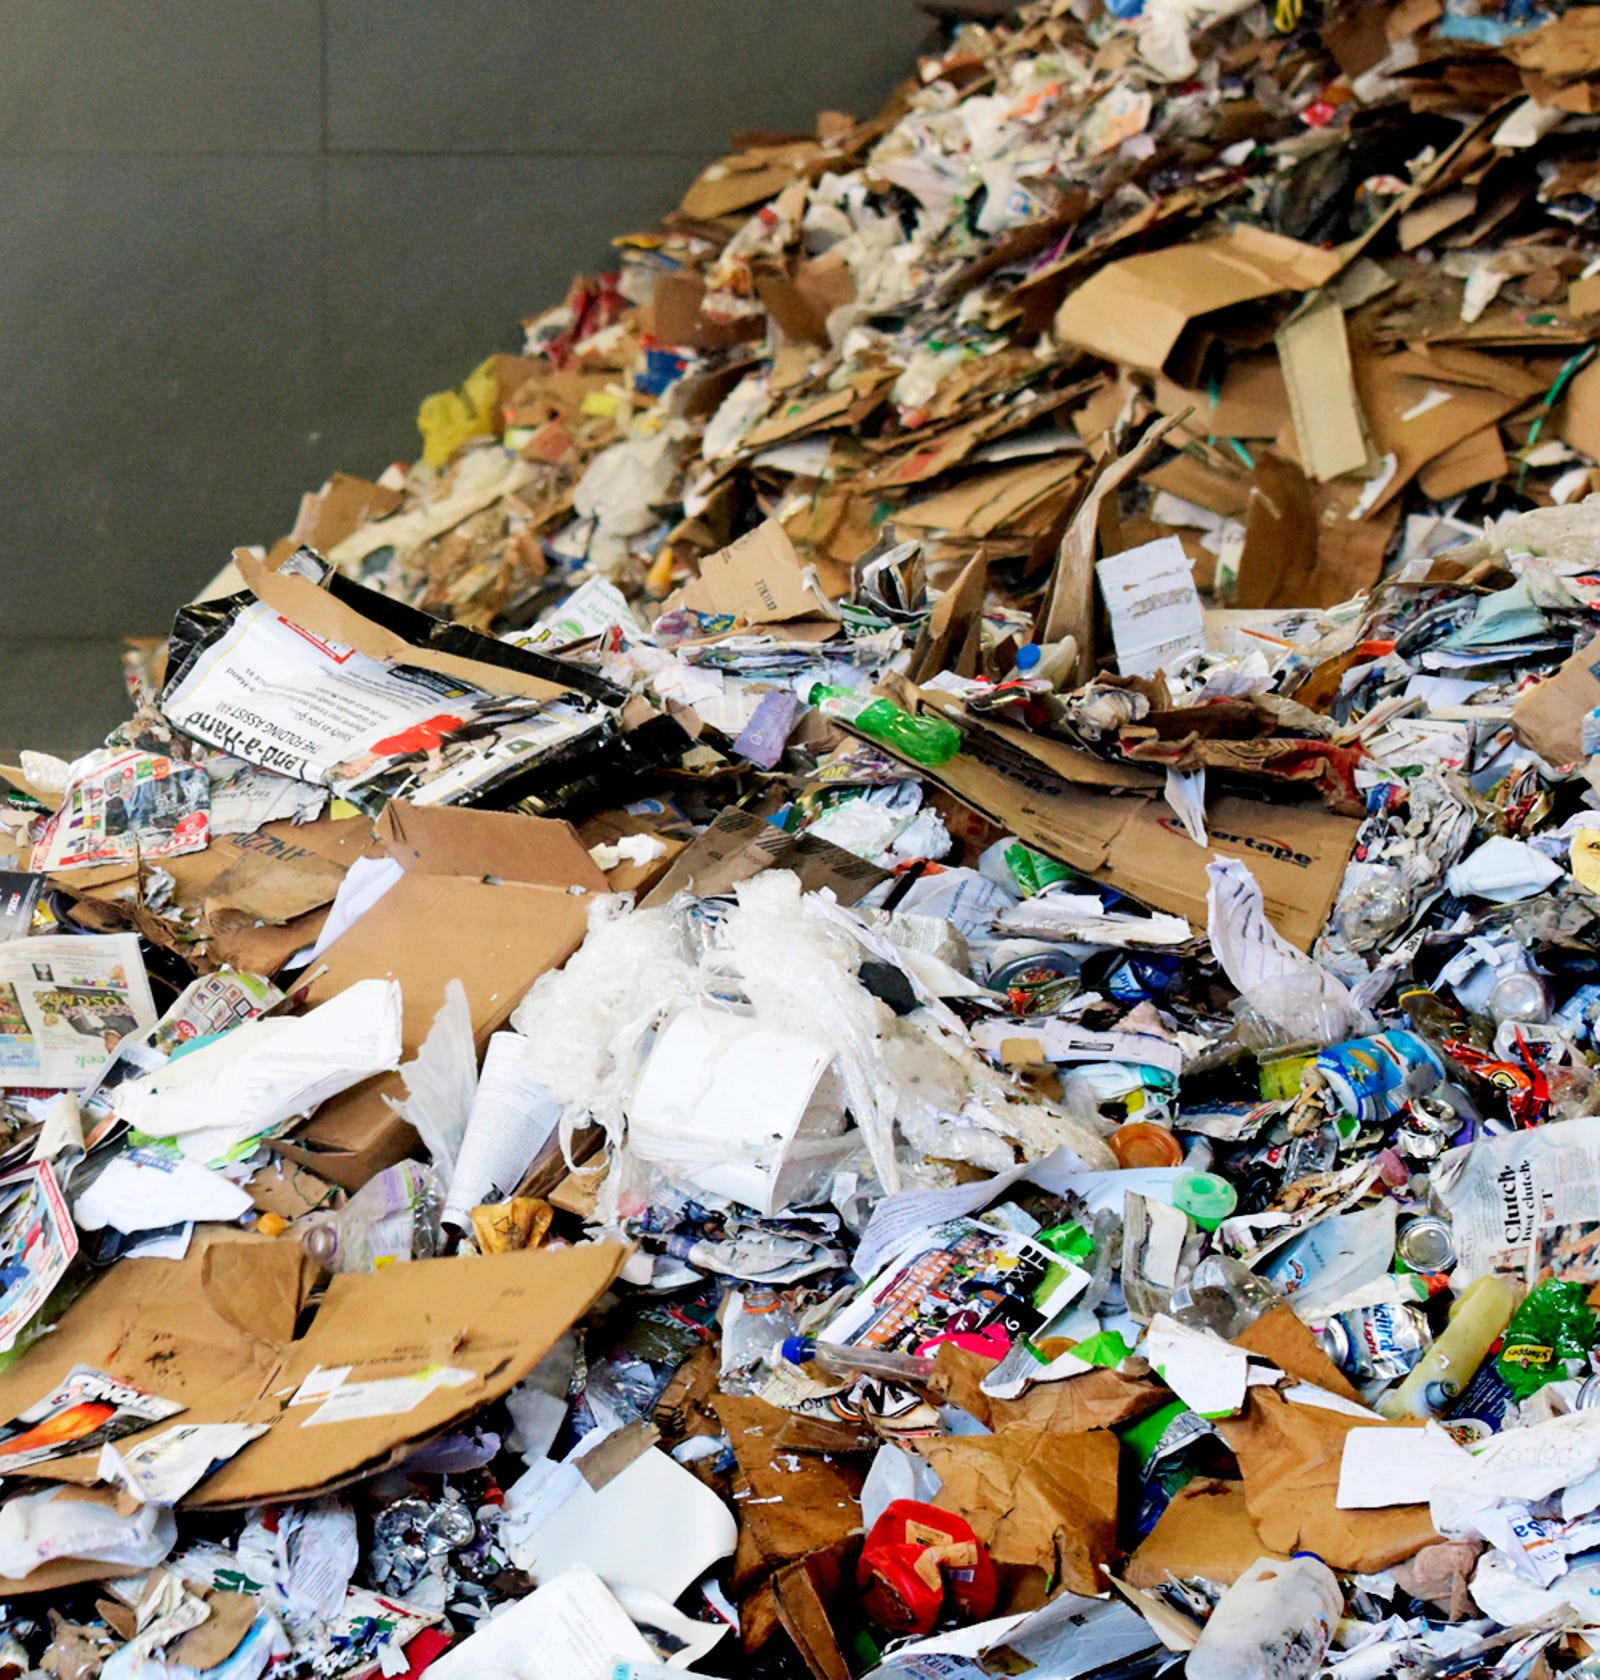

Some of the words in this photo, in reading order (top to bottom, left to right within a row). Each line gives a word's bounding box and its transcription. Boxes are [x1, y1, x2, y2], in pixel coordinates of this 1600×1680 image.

[260, 720, 303, 751] FOLDING
[299, 740, 321, 755] THE
[1519, 1159, 1536, 1209] clutch.
[1497, 1165, 1522, 1244] Clutch.
